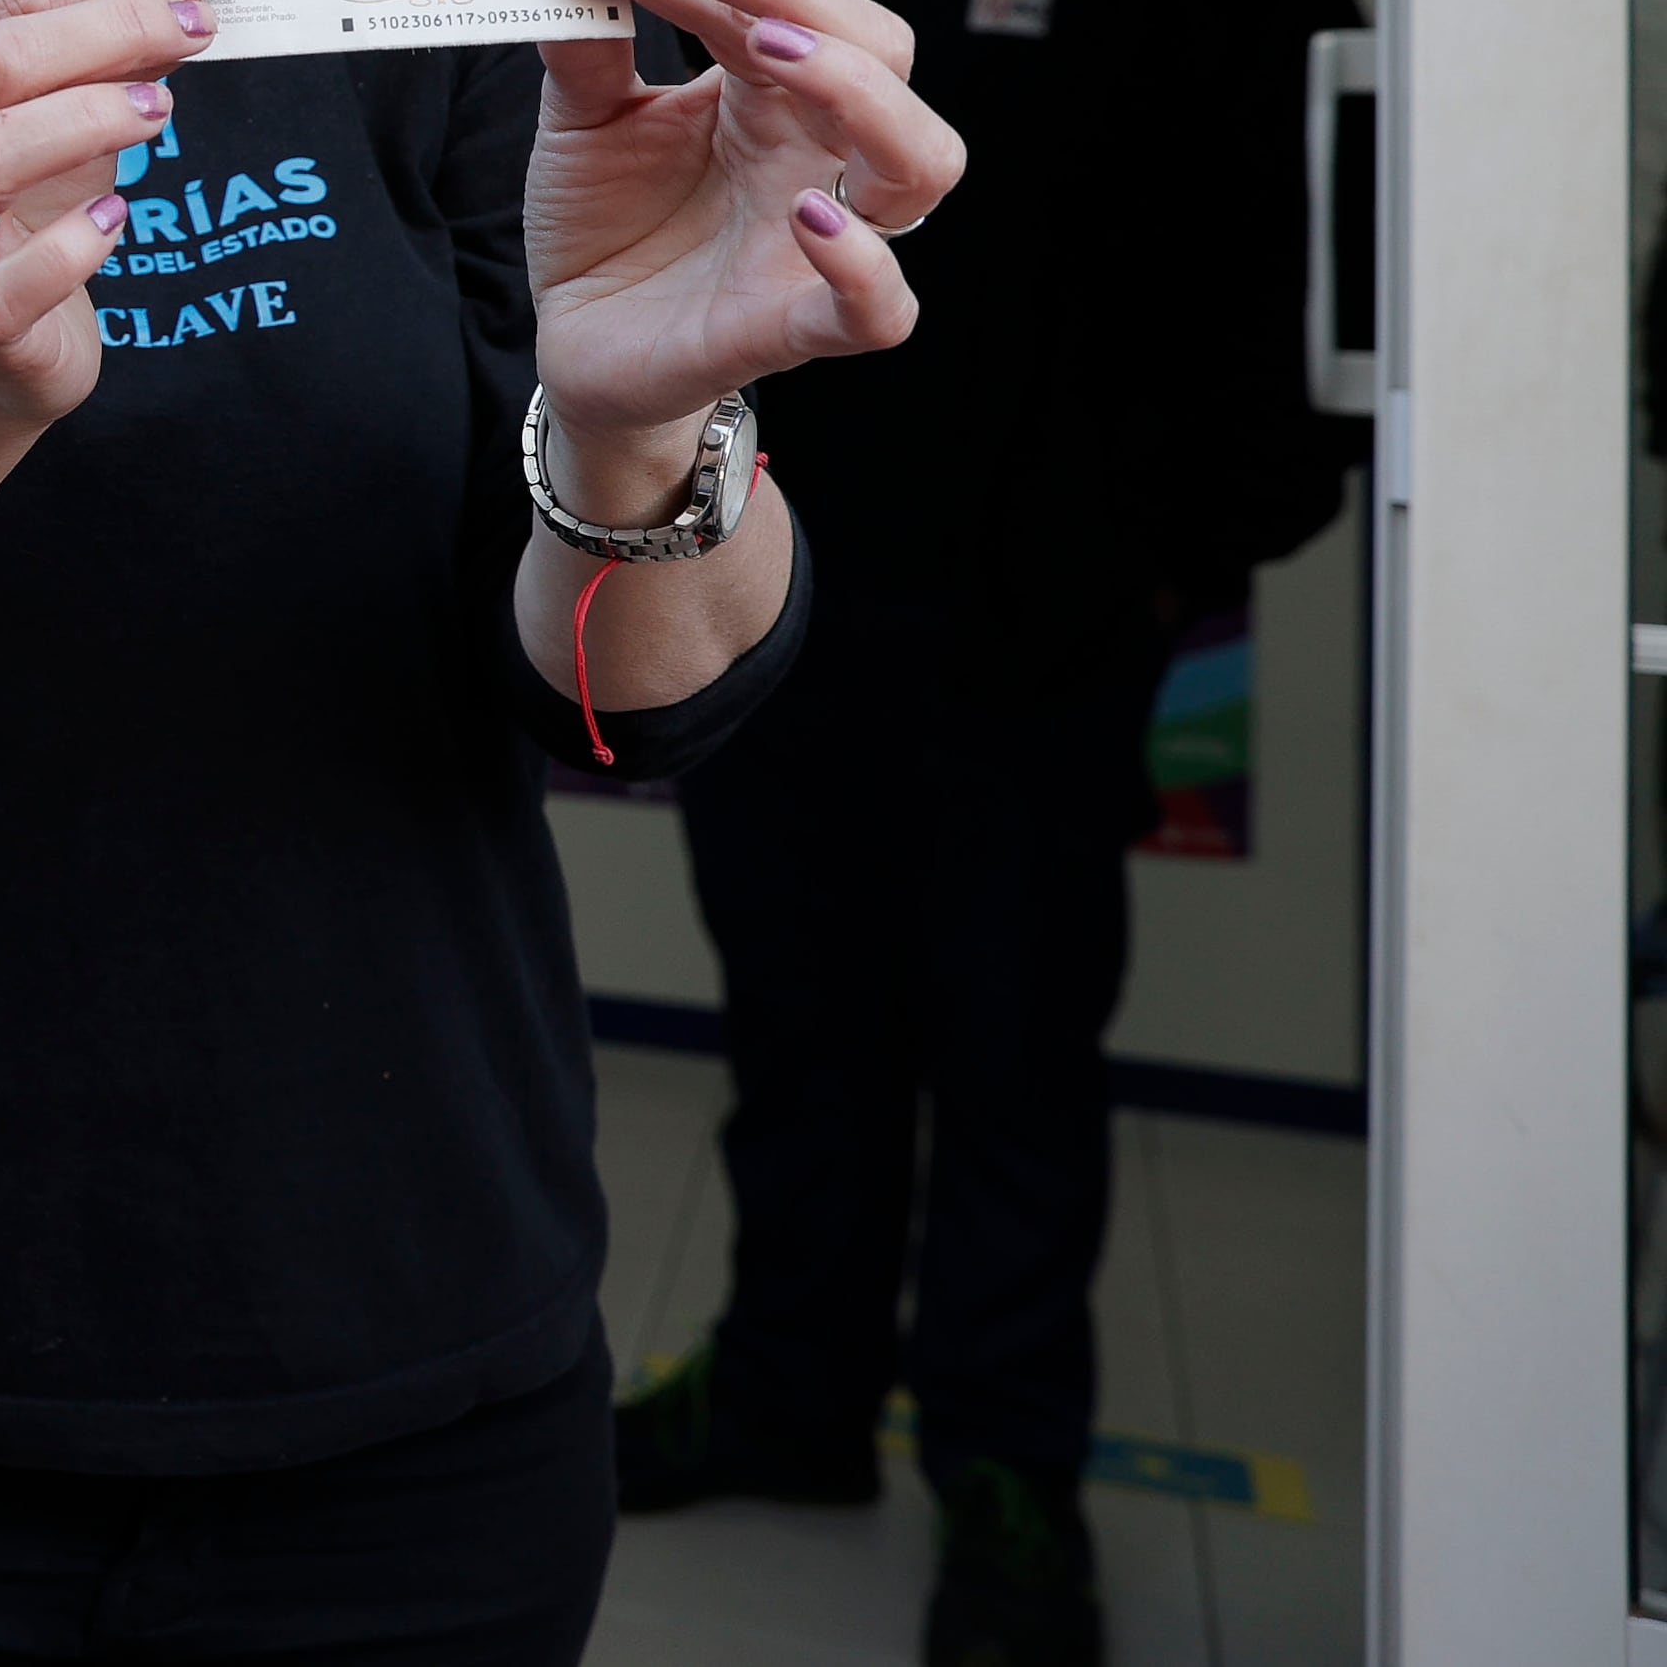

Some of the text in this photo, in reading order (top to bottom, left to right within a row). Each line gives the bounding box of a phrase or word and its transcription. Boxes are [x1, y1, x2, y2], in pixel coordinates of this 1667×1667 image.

[256, 14, 269, 23] del
[117, 156, 328, 247] RÍAS
[128, 250, 196, 277] DEL
[202, 214, 337, 265] ESTADO
[95, 280, 298, 349] CLAVE
